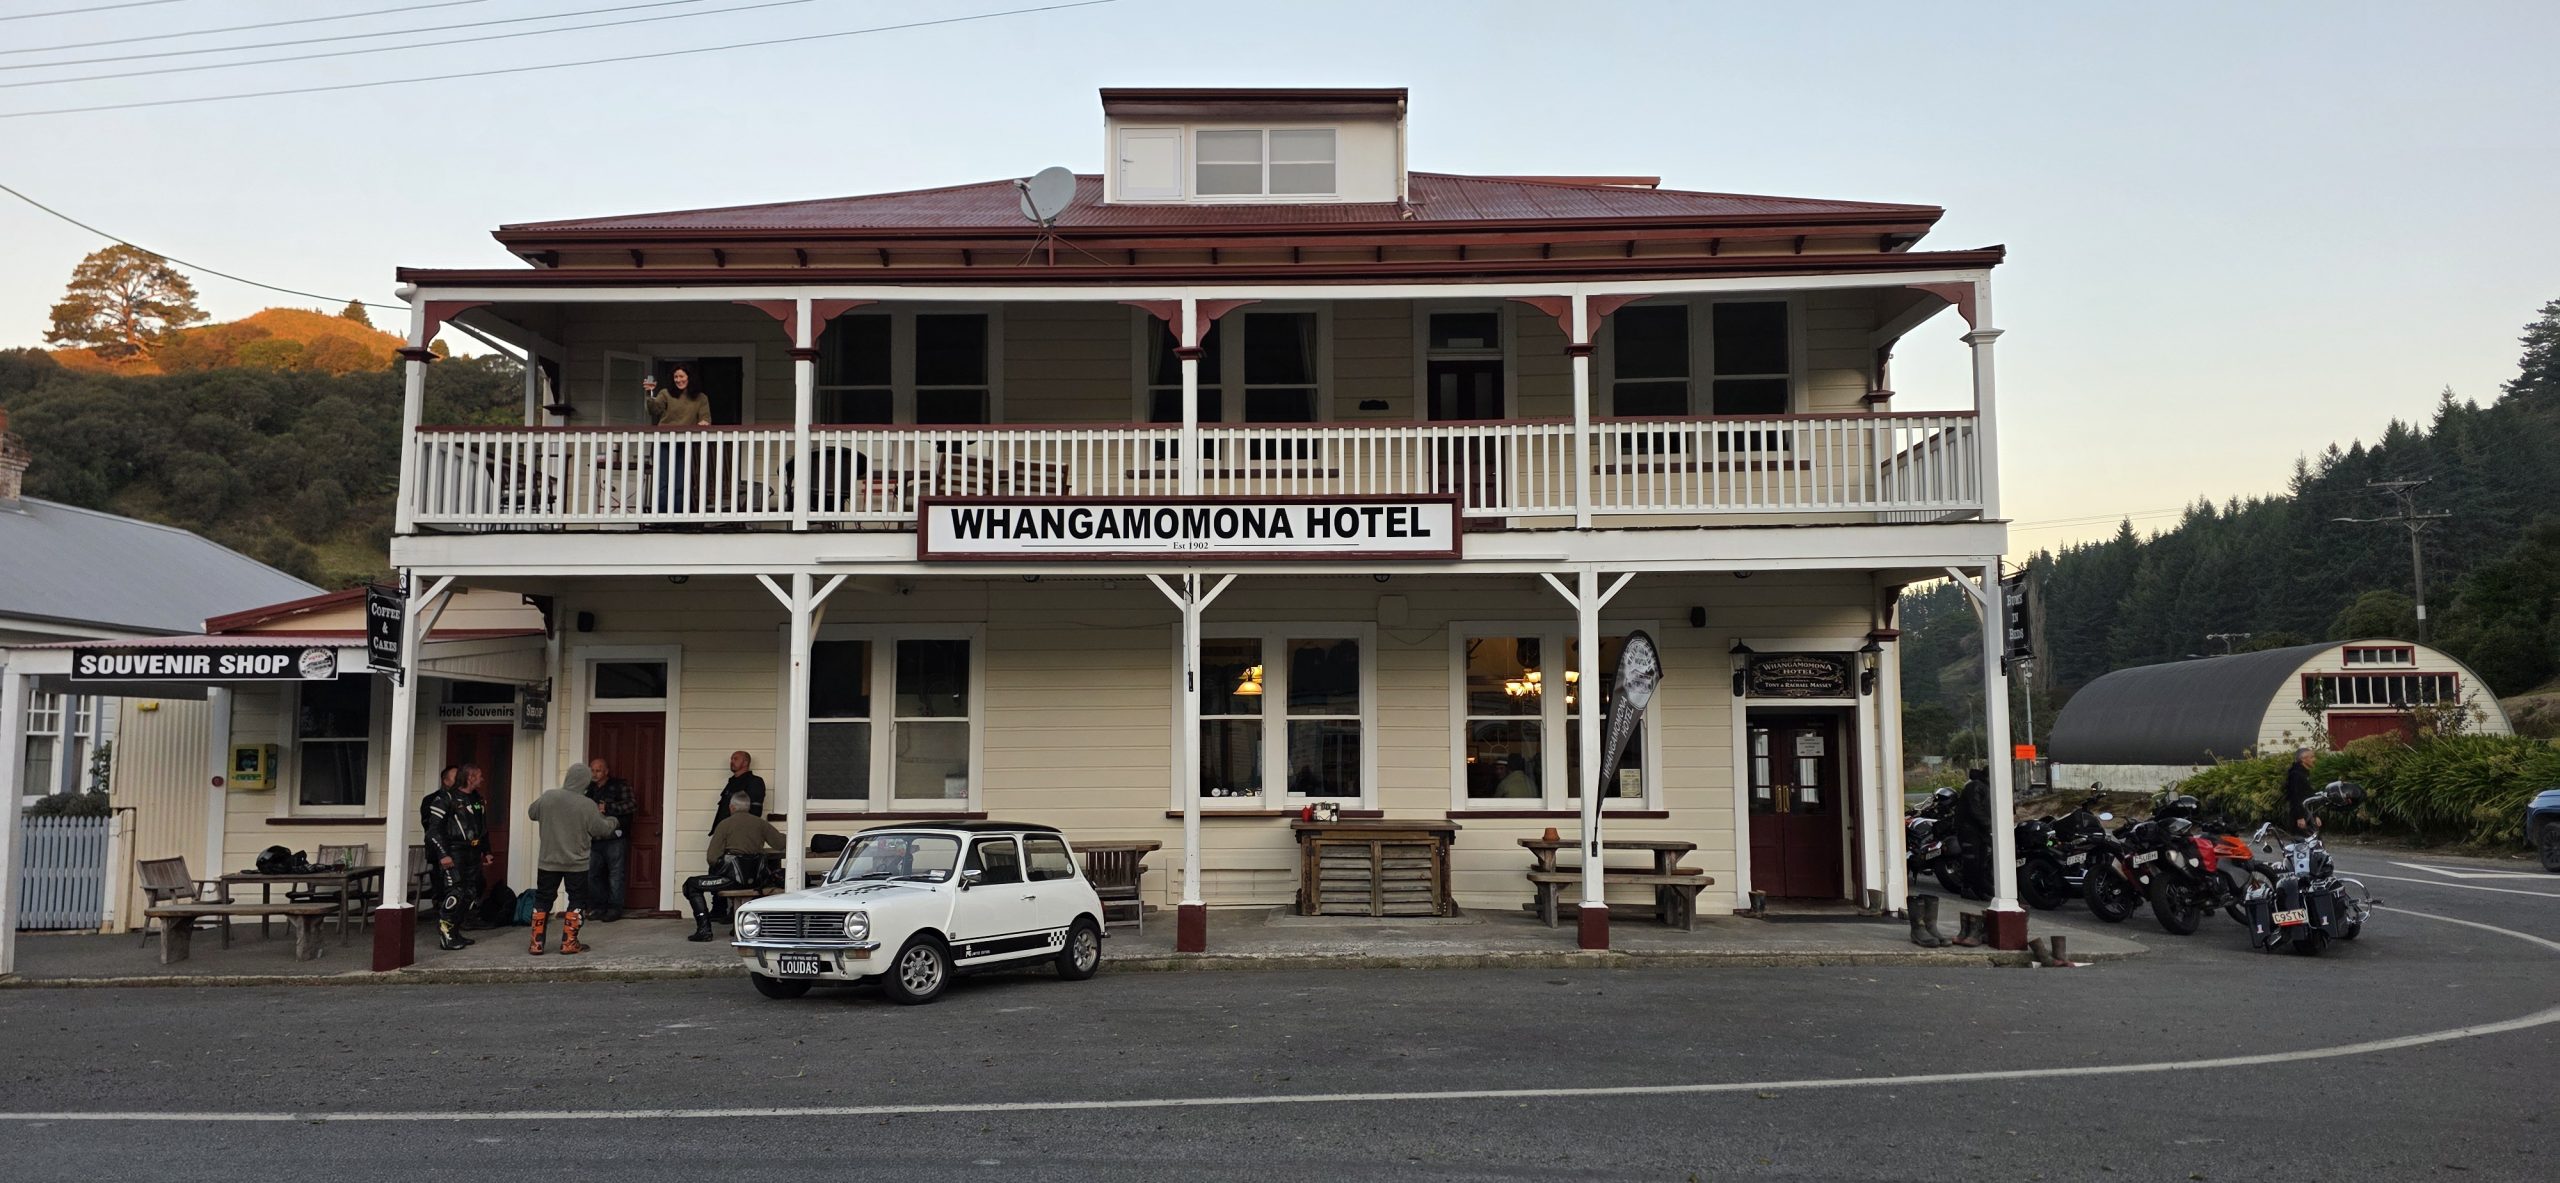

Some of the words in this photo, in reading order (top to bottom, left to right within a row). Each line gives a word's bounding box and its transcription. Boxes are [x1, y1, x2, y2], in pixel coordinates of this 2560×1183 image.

[951, 507, 1295, 540] WHANGAMOMONA
[1307, 506, 1431, 539] HOTEL
[1173, 541, 1186, 550] Est
[1189, 541, 1209, 550] 1902
[382, 621, 388, 634] &
[79, 654, 211, 675] SOUVENIR
[218, 654, 290, 675] SHOP
[439, 705, 465, 717] Hotel
[467, 705, 515, 717] Souvenirs
[1621, 707, 1635, 739] HOTEL
[1602, 695, 1628, 779] WHANGAMOMONA
[781, 960, 819, 975] LOUDAS
